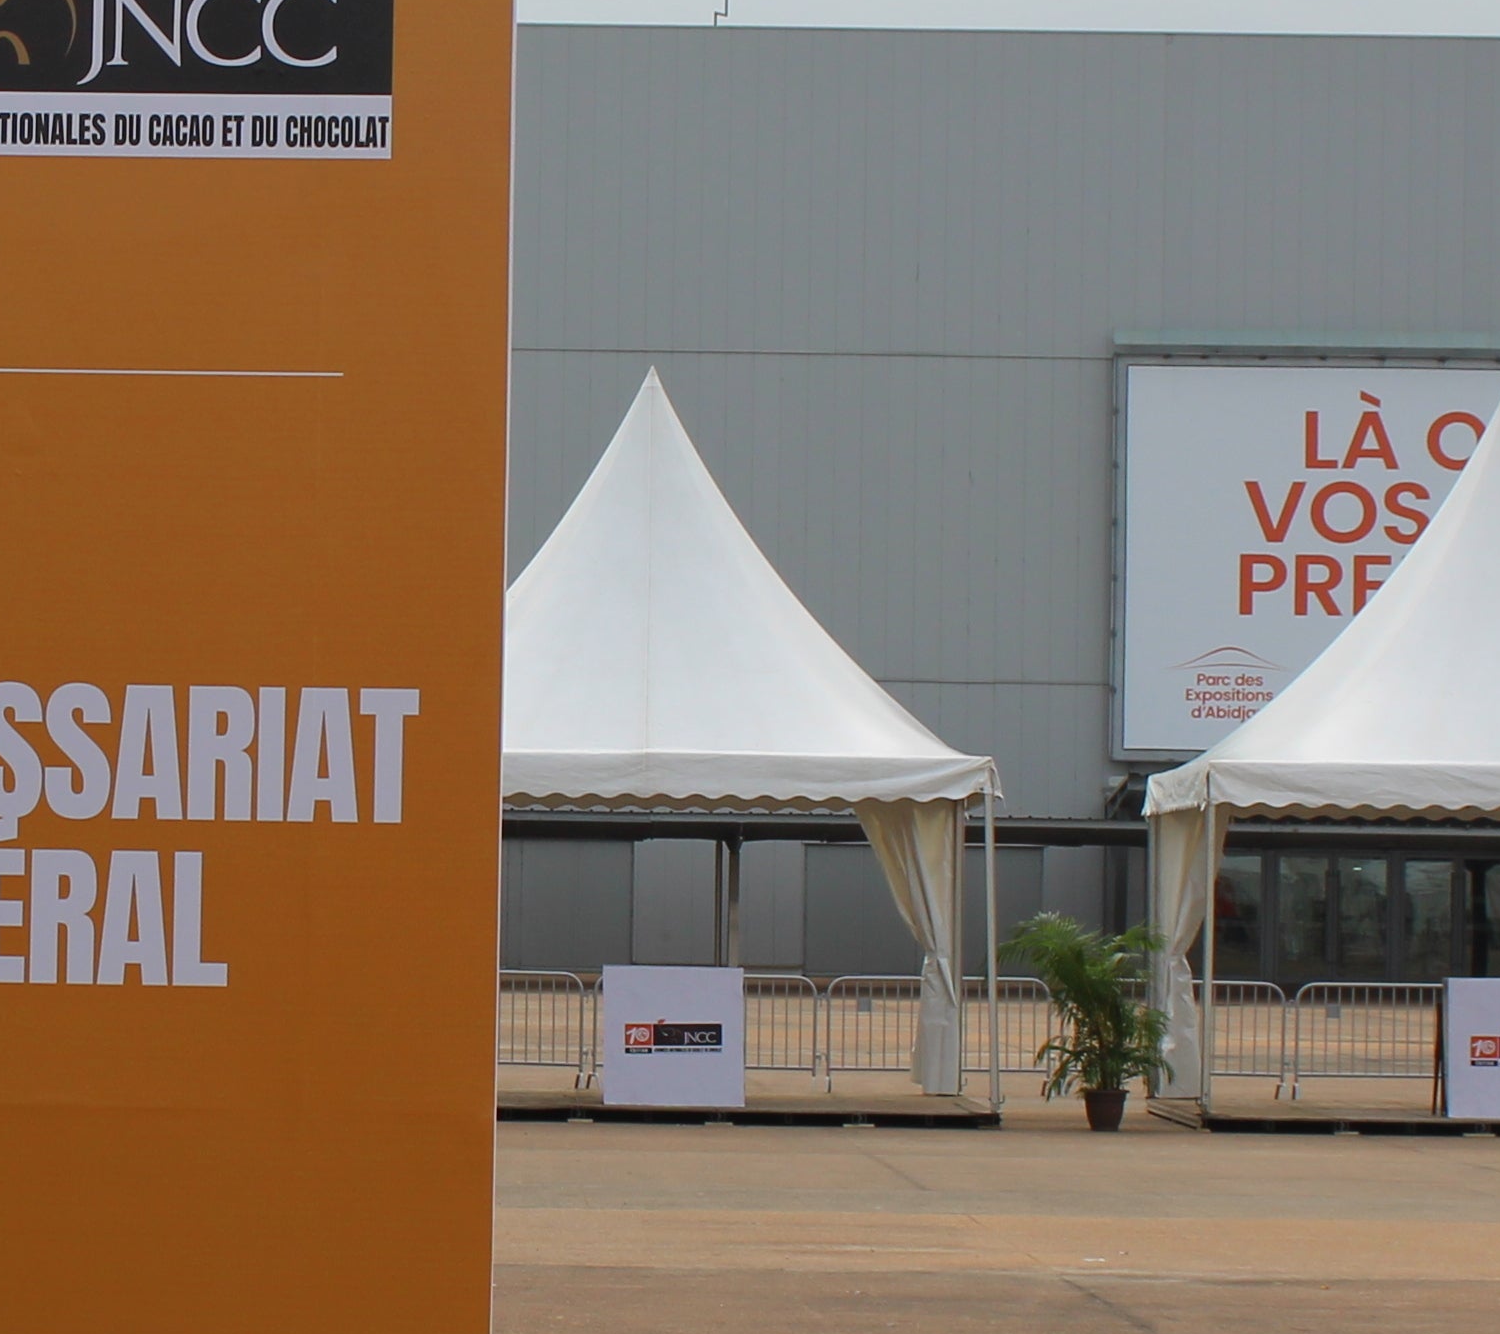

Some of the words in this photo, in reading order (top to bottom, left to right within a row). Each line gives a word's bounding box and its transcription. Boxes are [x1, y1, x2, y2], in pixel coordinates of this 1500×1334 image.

[114, 113, 141, 146] DU
[148, 114, 215, 147] CACAO
[221, 115, 245, 147] ET
[251, 115, 279, 147] DU
[285, 116, 389, 148] CHOCOLAT
[1303, 390, 1400, 471] LÀ
[1244, 480, 1430, 545] VOS
[1196, 673, 1231, 686] Parc
[1235, 673, 1263, 686] des
[1185, 688, 1274, 704] Expositions
[683, 1031, 717, 1045] JNCC
